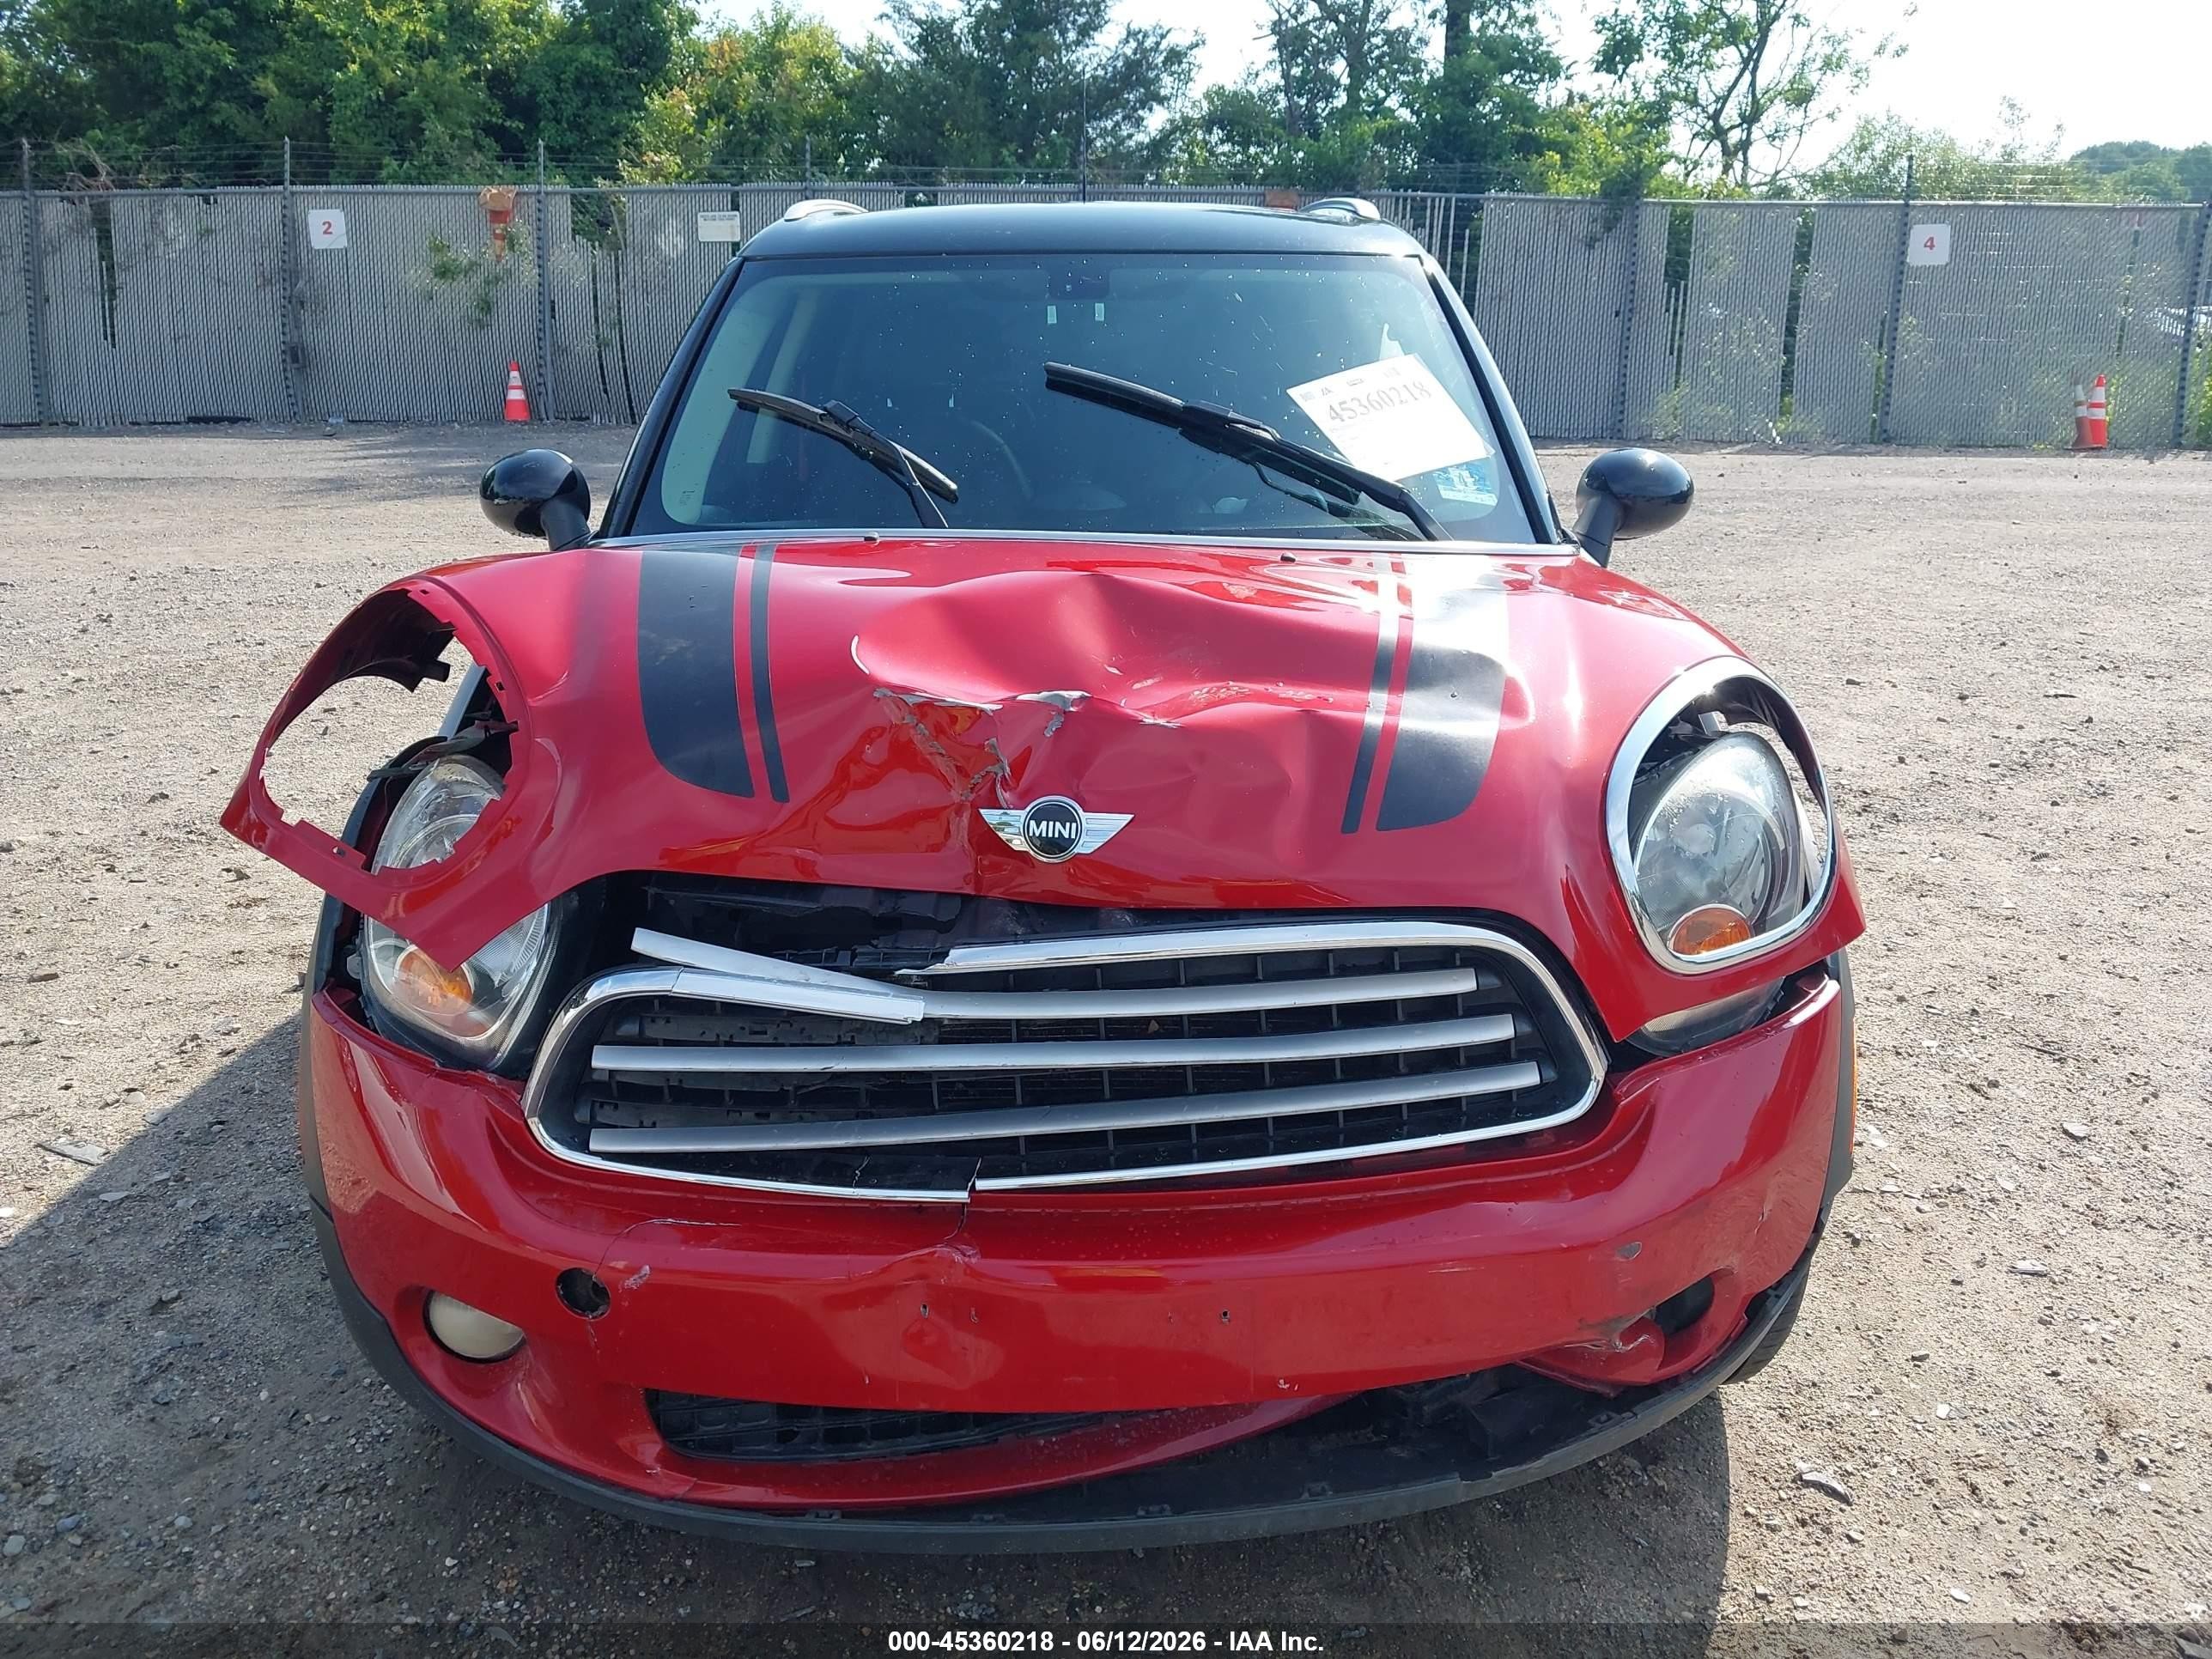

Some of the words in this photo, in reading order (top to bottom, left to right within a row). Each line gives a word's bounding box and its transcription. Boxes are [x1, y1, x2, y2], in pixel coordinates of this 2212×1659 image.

[322, 221, 333, 235] 2
[1923, 236, 1936, 251] 4
[1328, 380, 1433, 422] 45360218
[1029, 820, 1078, 840] MINI
